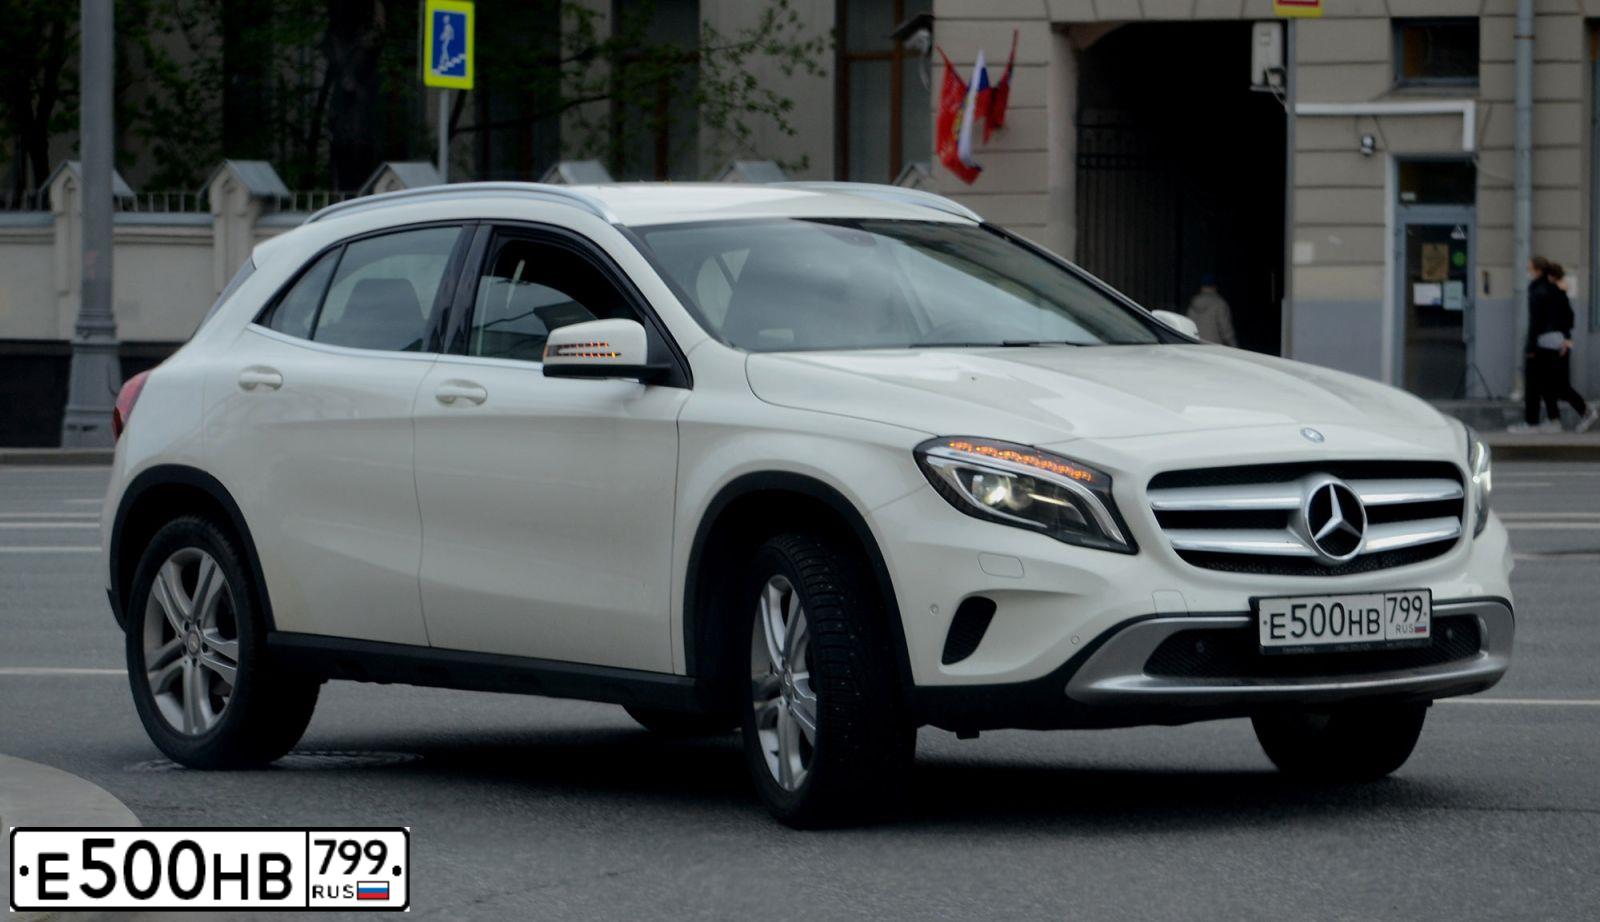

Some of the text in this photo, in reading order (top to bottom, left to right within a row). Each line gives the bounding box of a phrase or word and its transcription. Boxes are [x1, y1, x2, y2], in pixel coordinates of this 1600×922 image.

[1269, 595, 1423, 640] E500HB 799
[1395, 624, 1414, 634] RUS
